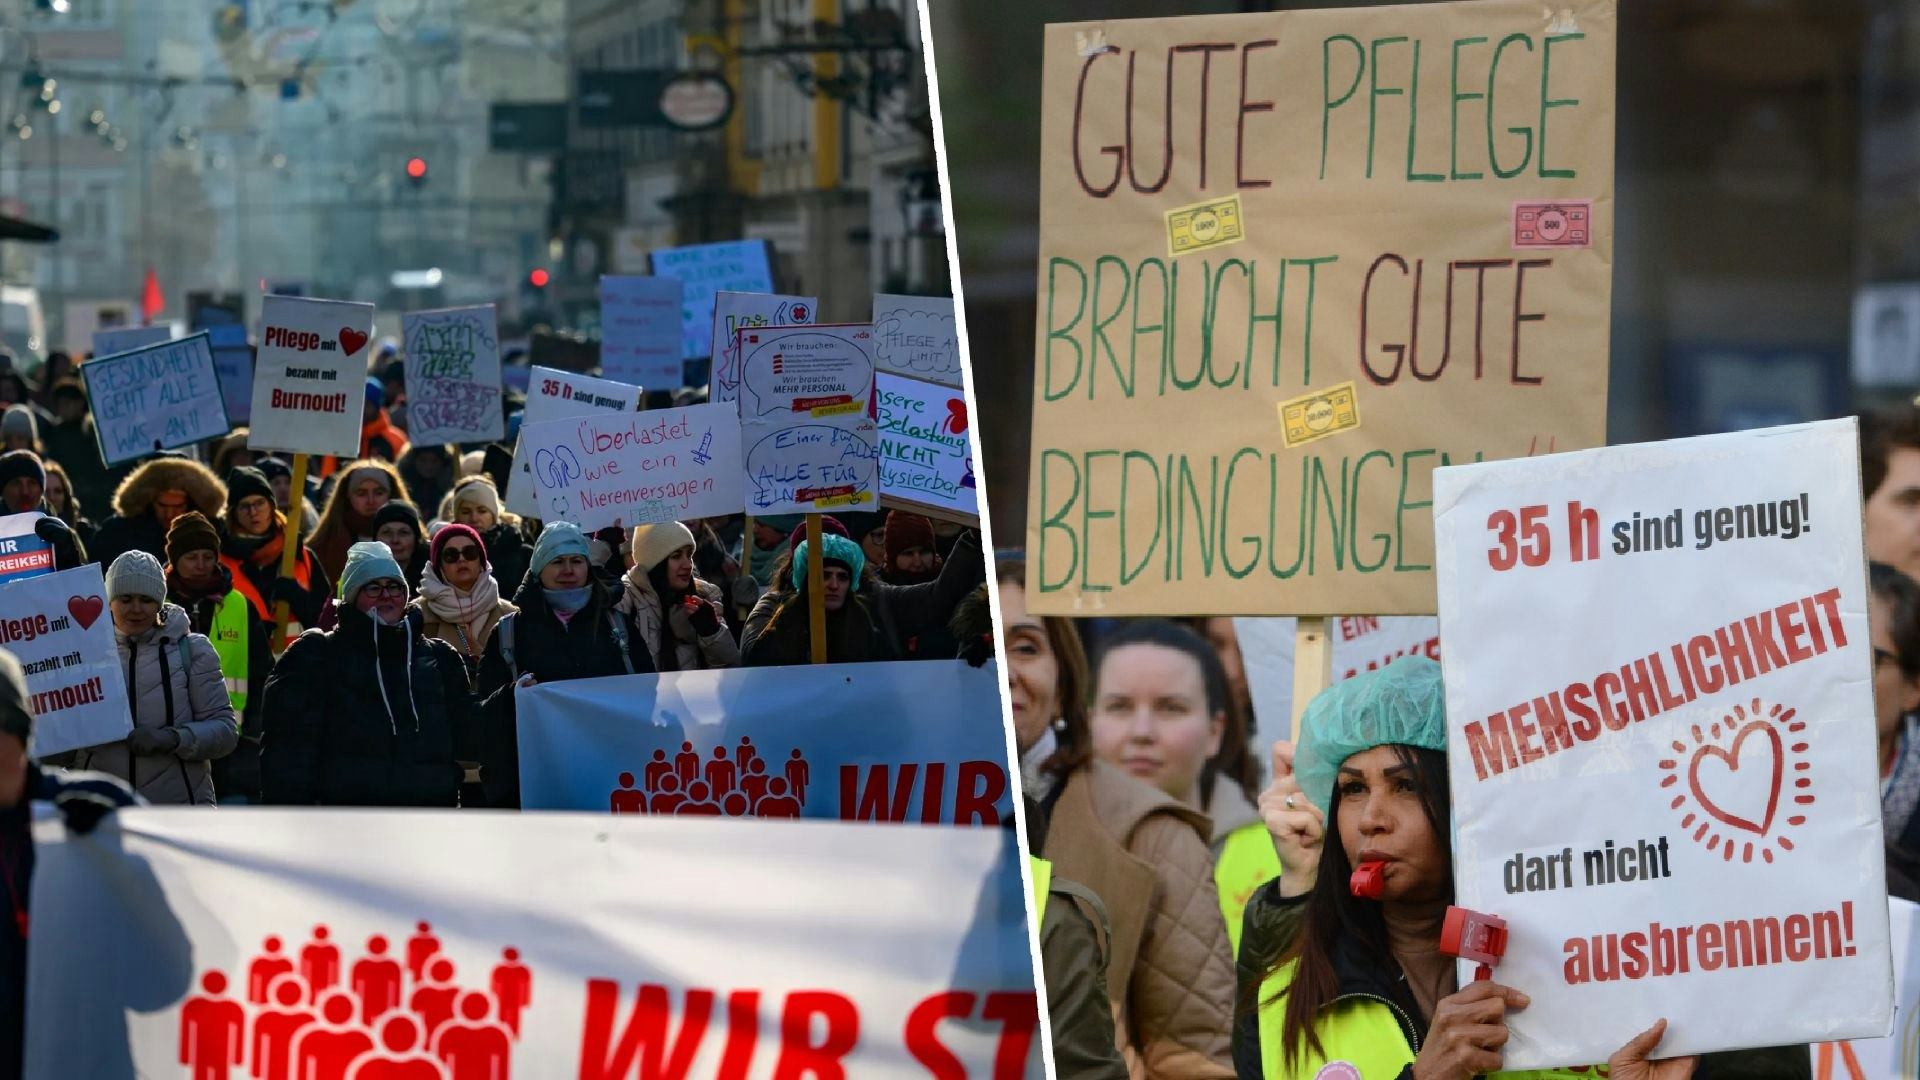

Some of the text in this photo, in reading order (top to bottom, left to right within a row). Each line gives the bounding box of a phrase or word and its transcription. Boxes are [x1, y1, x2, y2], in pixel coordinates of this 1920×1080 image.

[1073, 33, 1585, 199] GUTE PFLEGE
[1195, 220, 1215, 232] 1000
[1544, 220, 1560, 230] 500
[264, 326, 337, 352] Pflege mit
[1044, 252, 1554, 401] BRAUCHT GUTE
[779, 342, 795, 351] Wir
[94, 342, 203, 391] GESUNDHEIT
[286, 366, 337, 381] bezahlt mit
[782, 375, 836, 384] Wir brauchen
[102, 374, 201, 420] GEHT ALLE
[271, 388, 346, 413] Burnout!
[541, 379, 626, 411] 35 h sind genug!
[773, 383, 847, 394] MEHR PERSONAL
[875, 388, 925, 413] nsere
[112, 422, 150, 454] WAS
[577, 414, 693, 455] Überlastet
[776, 431, 823, 449] Einer
[876, 408, 965, 457] Belastung
[840, 443, 878, 461] ALLE
[878, 438, 940, 465] NICHT
[584, 455, 677, 482] wie ein
[759, 463, 857, 486] ALLE FÜR
[879, 459, 965, 495] lysierbar
[580, 476, 714, 512] Nierenversagen
[1039, 447, 1482, 593] BEDINGUNGE
[1486, 492, 1812, 572] 35 h sind genug!
[0, 540, 18, 554] IR
[0, 553, 50, 571] REIKEN!
[0, 613, 70, 645] flege mit
[63, 651, 82, 667] mit
[29, 676, 105, 717] urnout!
[1463, 586, 1848, 782] MENSCHLICHKEIT
[839, 760, 1006, 827] WIR
[1503, 835, 1672, 895] darf nicht
[1563, 901, 1858, 986] ausbrennen!
[577, 977, 1046, 1080] WIR ST
